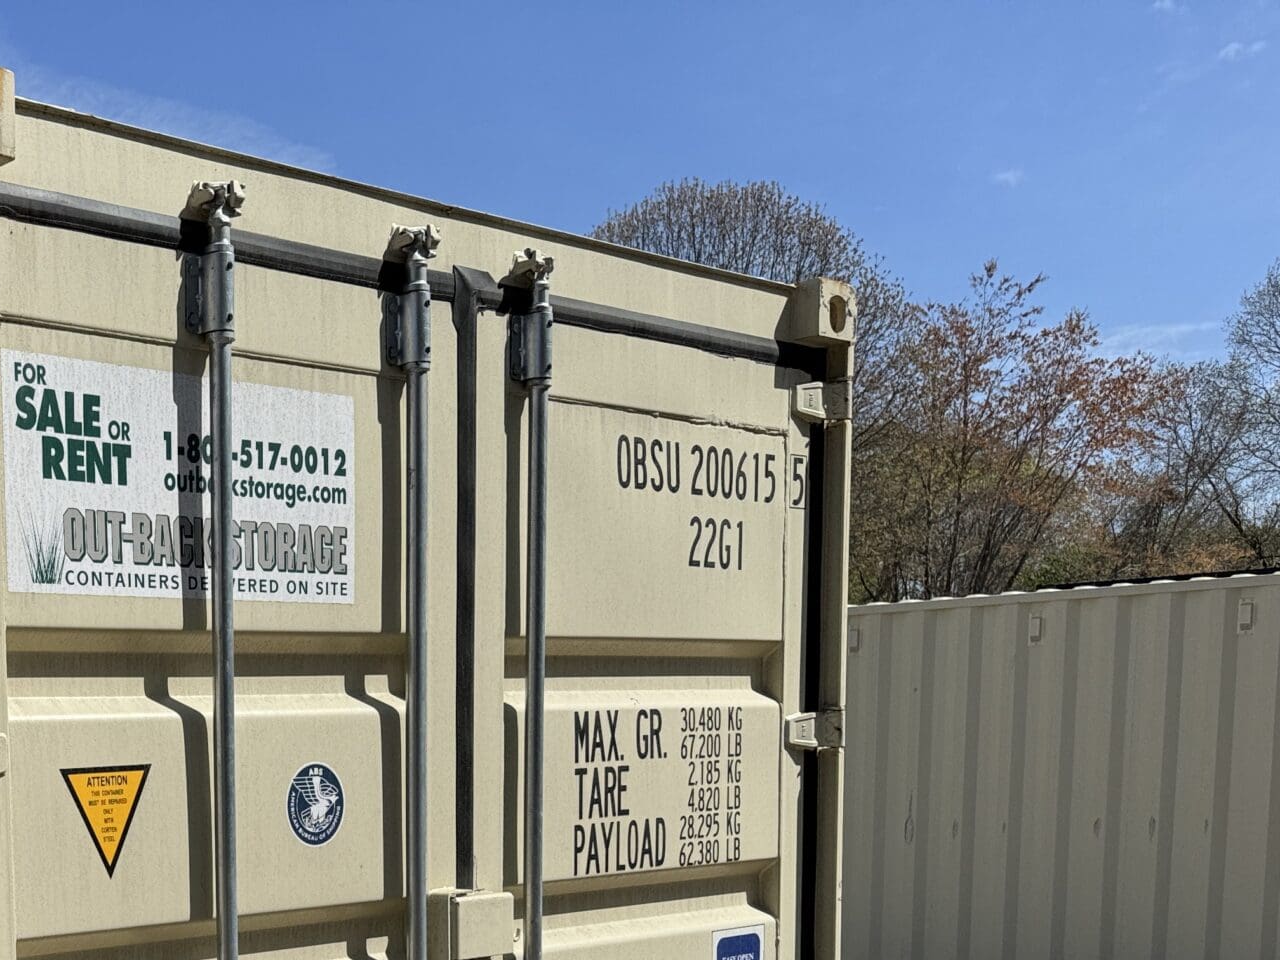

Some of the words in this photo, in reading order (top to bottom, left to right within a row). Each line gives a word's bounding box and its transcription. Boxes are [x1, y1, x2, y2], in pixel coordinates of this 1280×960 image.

[14, 362, 47, 385] FOR
[15, 384, 101, 438] SALE
[108, 420, 131, 441] OR
[41, 435, 132, 486] RENT
[164, 431, 347, 477] 1-80-517-0012
[617, 434, 680, 493] OBSU
[690, 444, 776, 503] 200615
[792, 458, 804, 506] 5
[688, 516, 743, 570] 22G1
[65, 569, 180, 590] CONTAINERS
[188, 575, 279, 594] DEERED
[286, 579, 309, 595] ON
[316, 580, 348, 596] SITE
[574, 710, 624, 763] MAX.
[636, 709, 667, 759] GR.
[680, 707, 721, 732] 30,480
[727, 706, 743, 731] KG
[680, 734, 721, 760] 67,200
[727, 733, 742, 757] LB
[87, 775, 128, 787] ATTENTION
[574, 765, 630, 820] TARE
[688, 760, 721, 786] 2,185
[727, 759, 742, 784] KG
[688, 787, 720, 813] 4,820
[726, 786, 741, 810] LB
[573, 817, 666, 876] PAYLOAD
[679, 813, 720, 840] 28,295
[726, 812, 741, 836] KG
[679, 839, 720, 867] 62,380
[726, 838, 741, 862] LB
